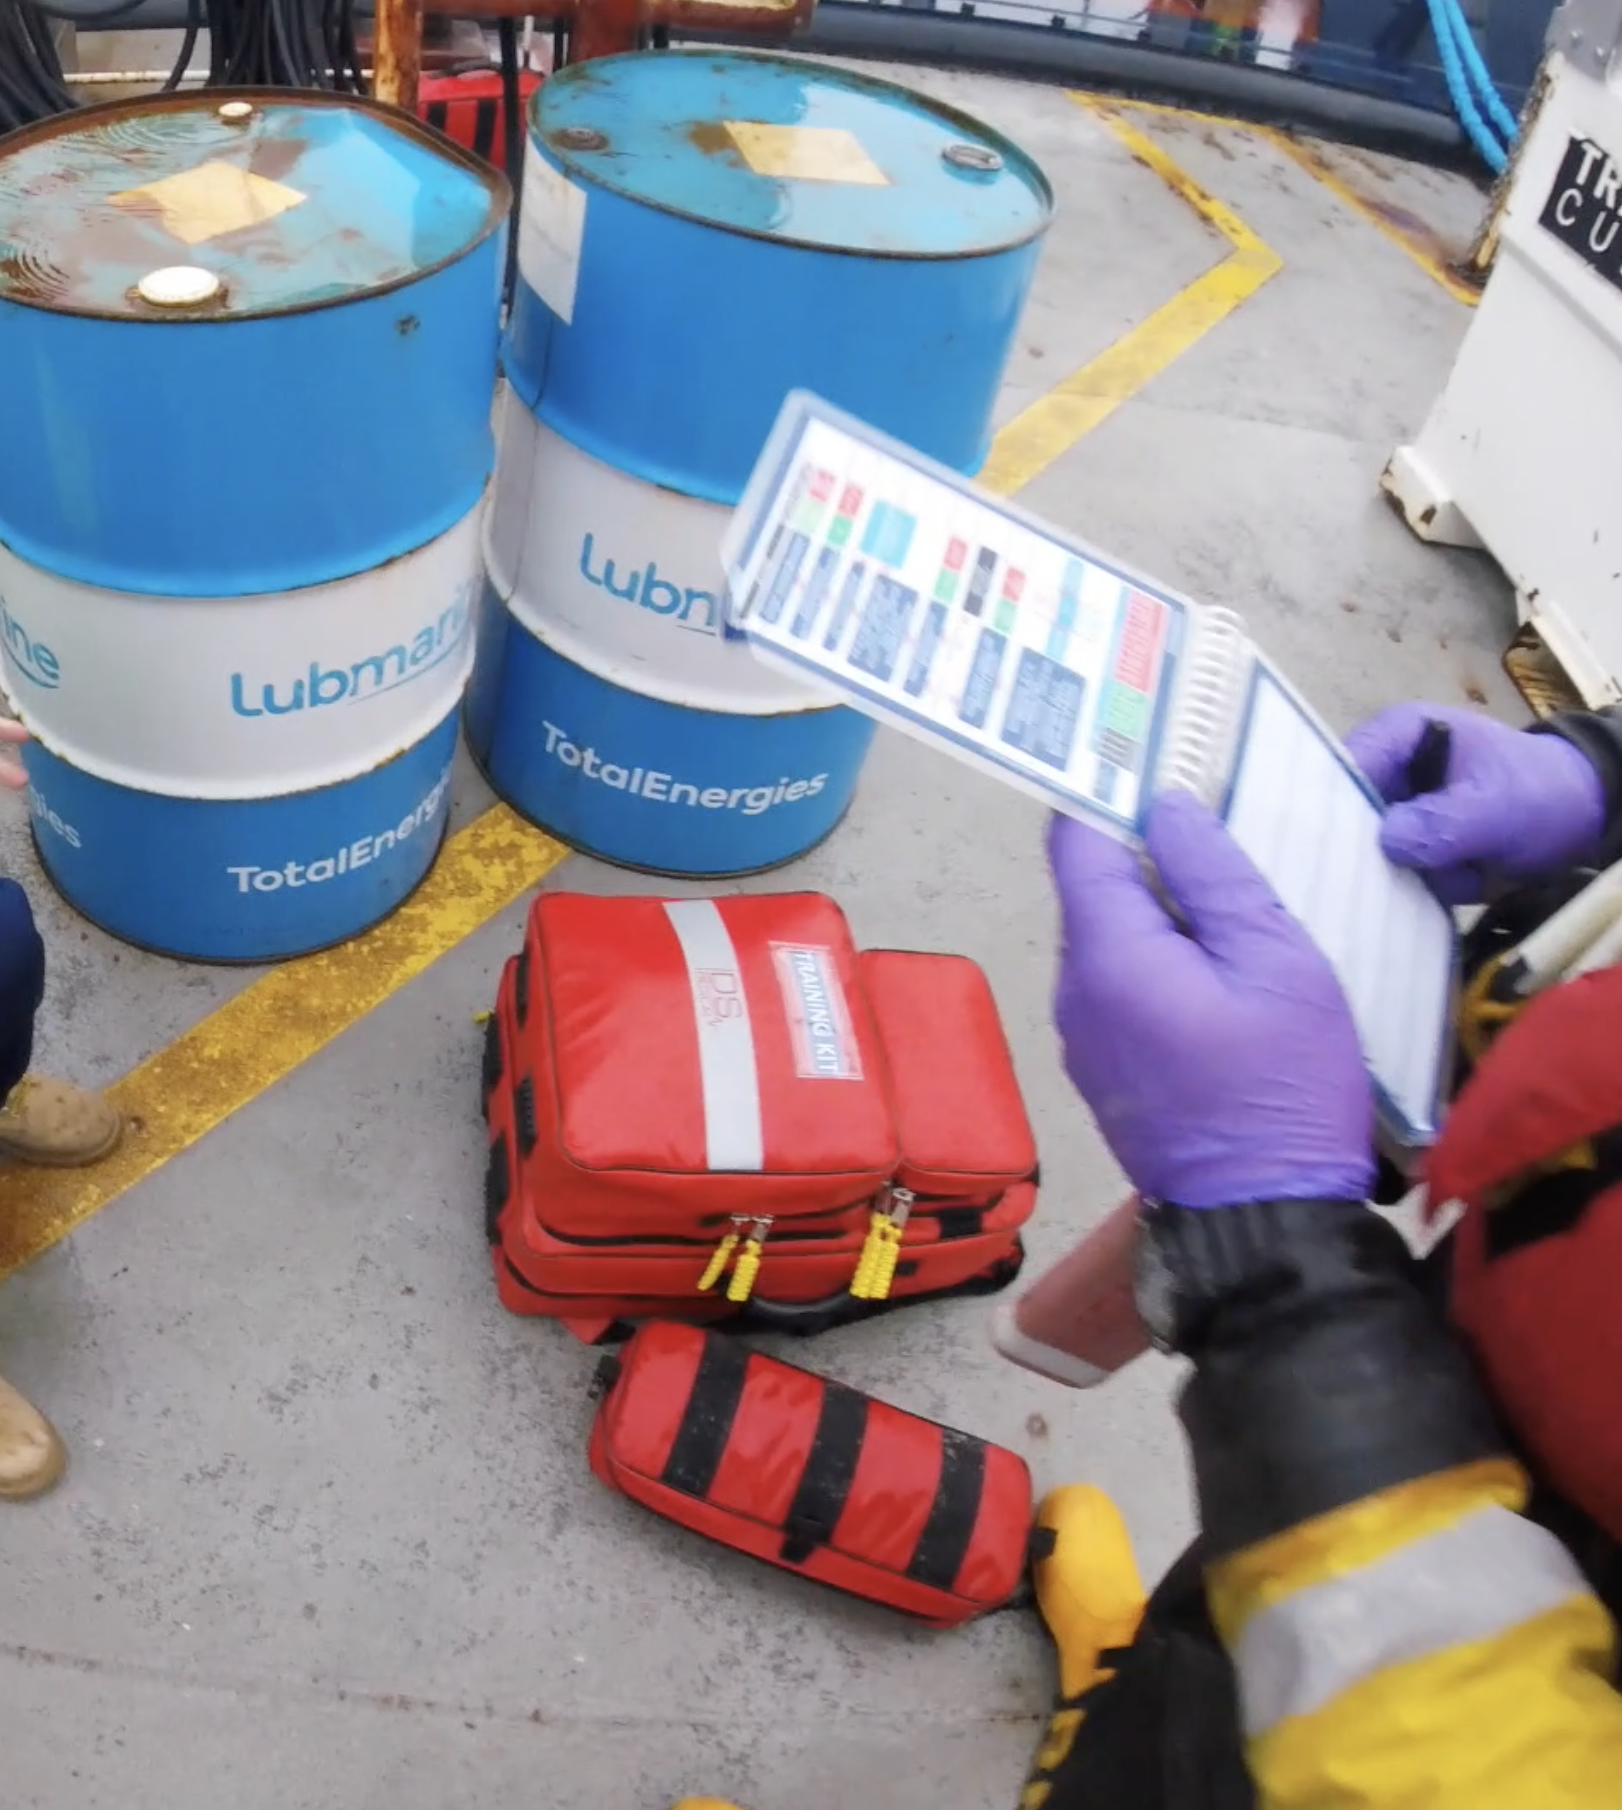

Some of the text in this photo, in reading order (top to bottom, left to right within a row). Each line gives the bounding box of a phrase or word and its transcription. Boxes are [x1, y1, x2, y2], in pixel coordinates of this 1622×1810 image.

[1575, 141, 1622, 217] TR
[1555, 188, 1622, 266] CU
[542, 720, 829, 816] TotalEnergies
[791, 950, 839, 1076] TRAINING KIT
